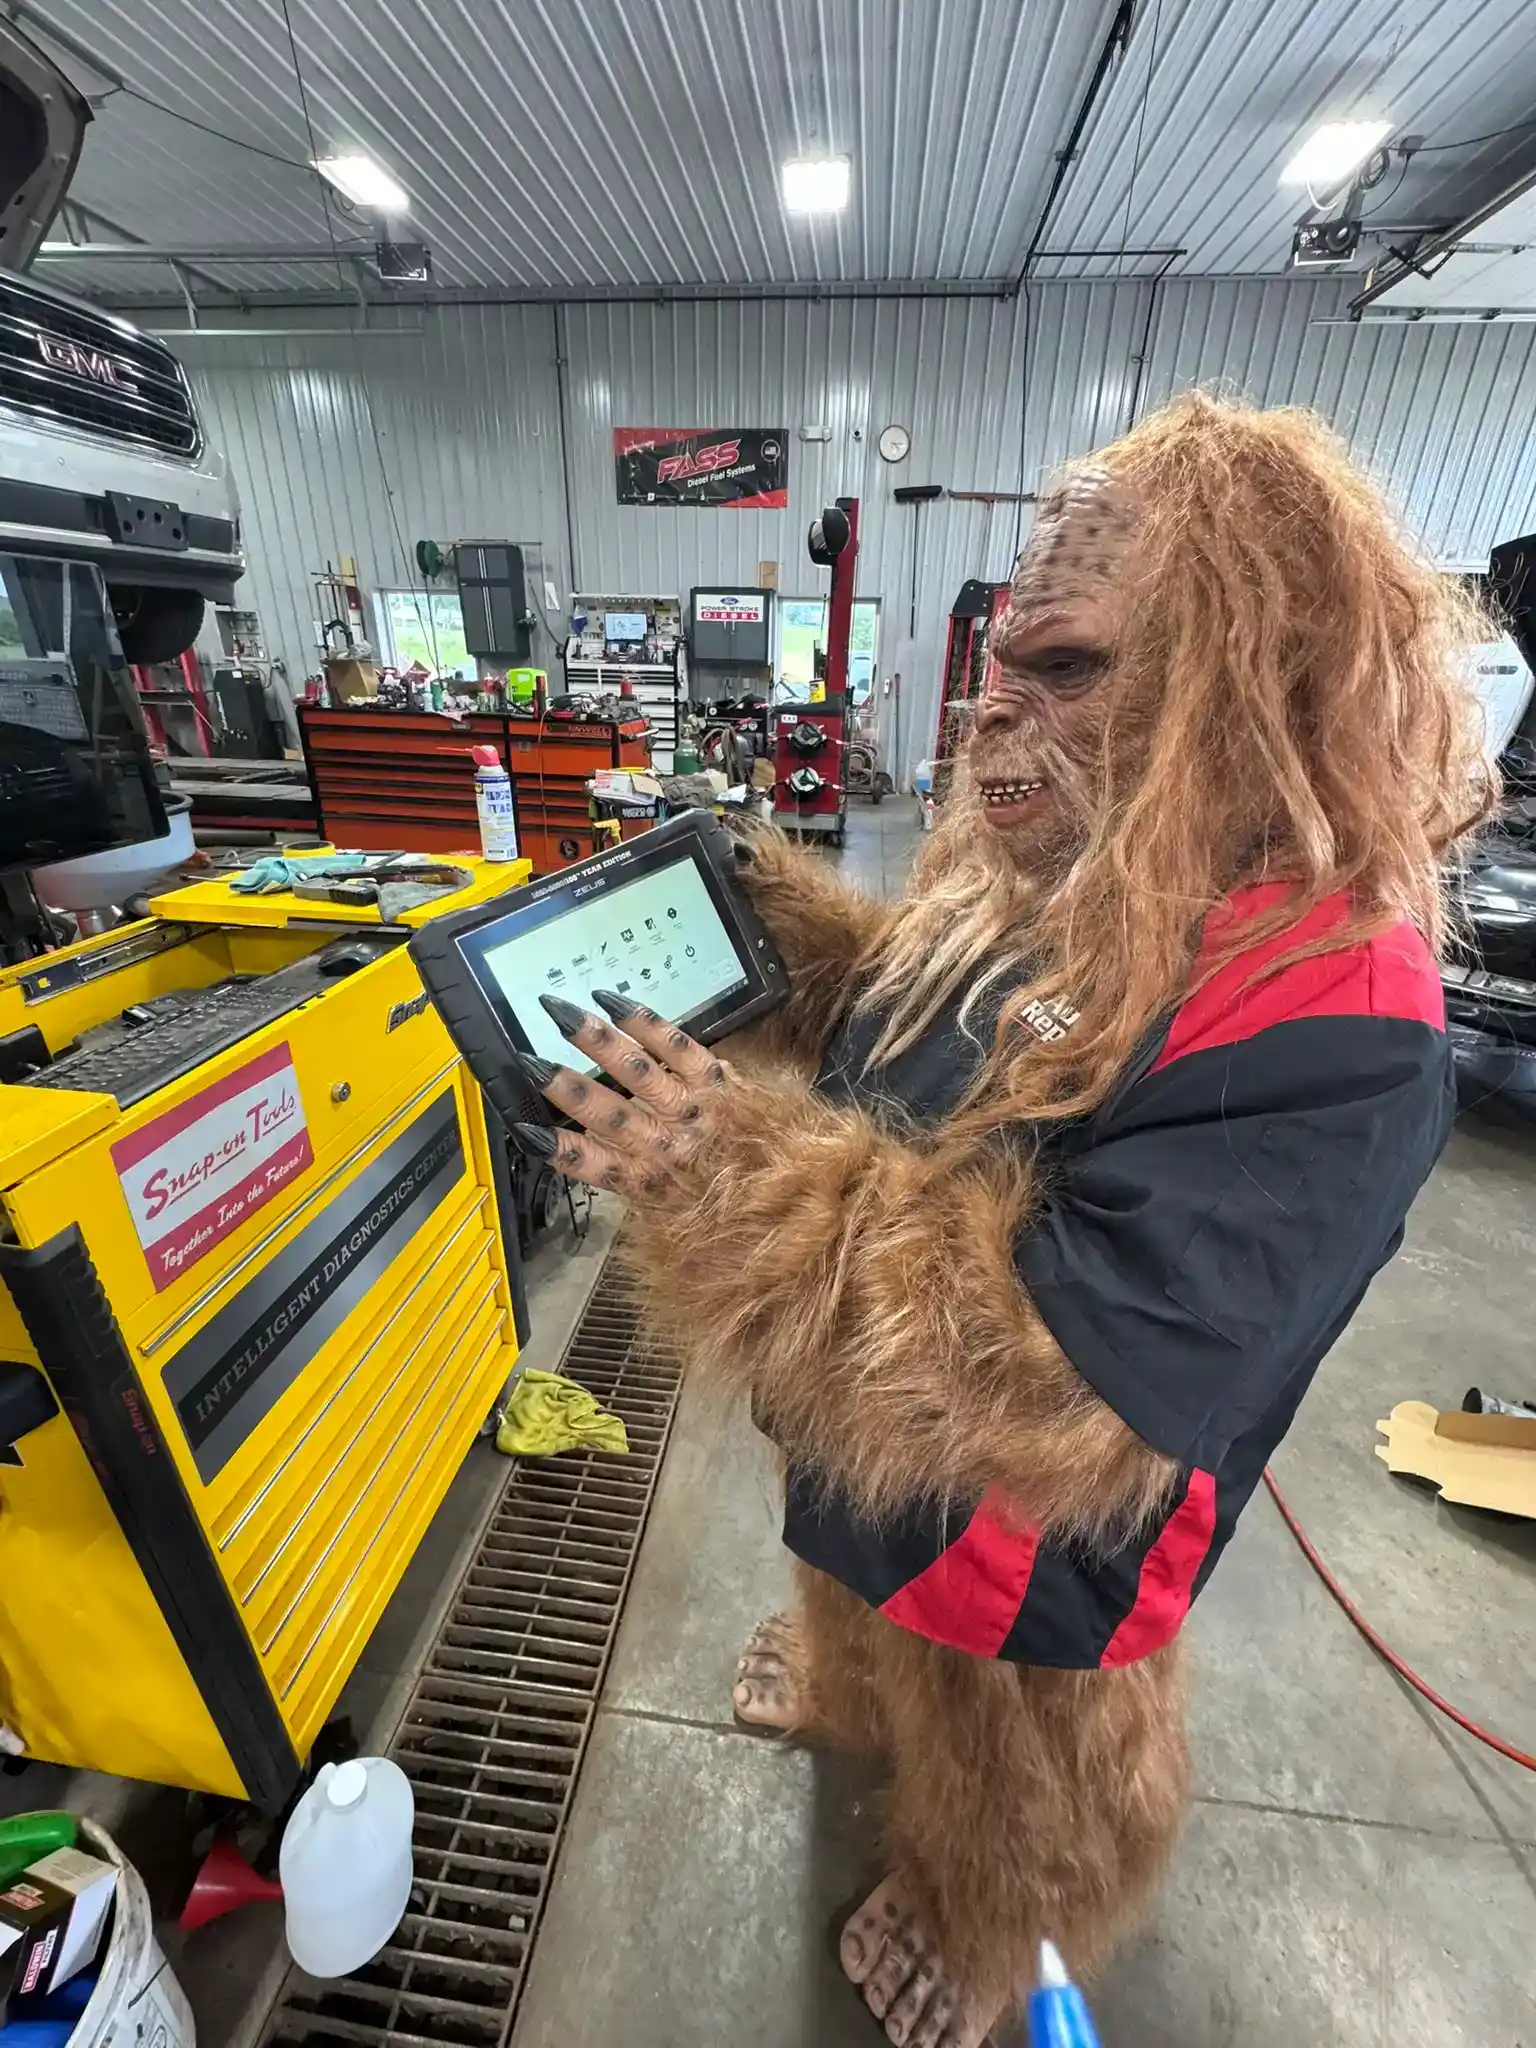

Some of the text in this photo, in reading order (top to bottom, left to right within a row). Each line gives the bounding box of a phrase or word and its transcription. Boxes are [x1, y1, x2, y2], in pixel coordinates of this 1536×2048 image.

[37, 333, 143, 395] GMC
[657, 439, 742, 484] FASS
[688, 464, 756, 487] Diesel Fuel Systems
[573, 878, 606, 897] ZEUS
[581, 864, 602, 877] YEAR
[602, 850, 632, 868] EDITION
[143, 1088, 296, 1221] Snap-on Tools
[161, 1144, 304, 1272] Together Into the Future!
[195, 1129, 458, 1422] INTELLIGENT DIAGNOSTICS CENTER
